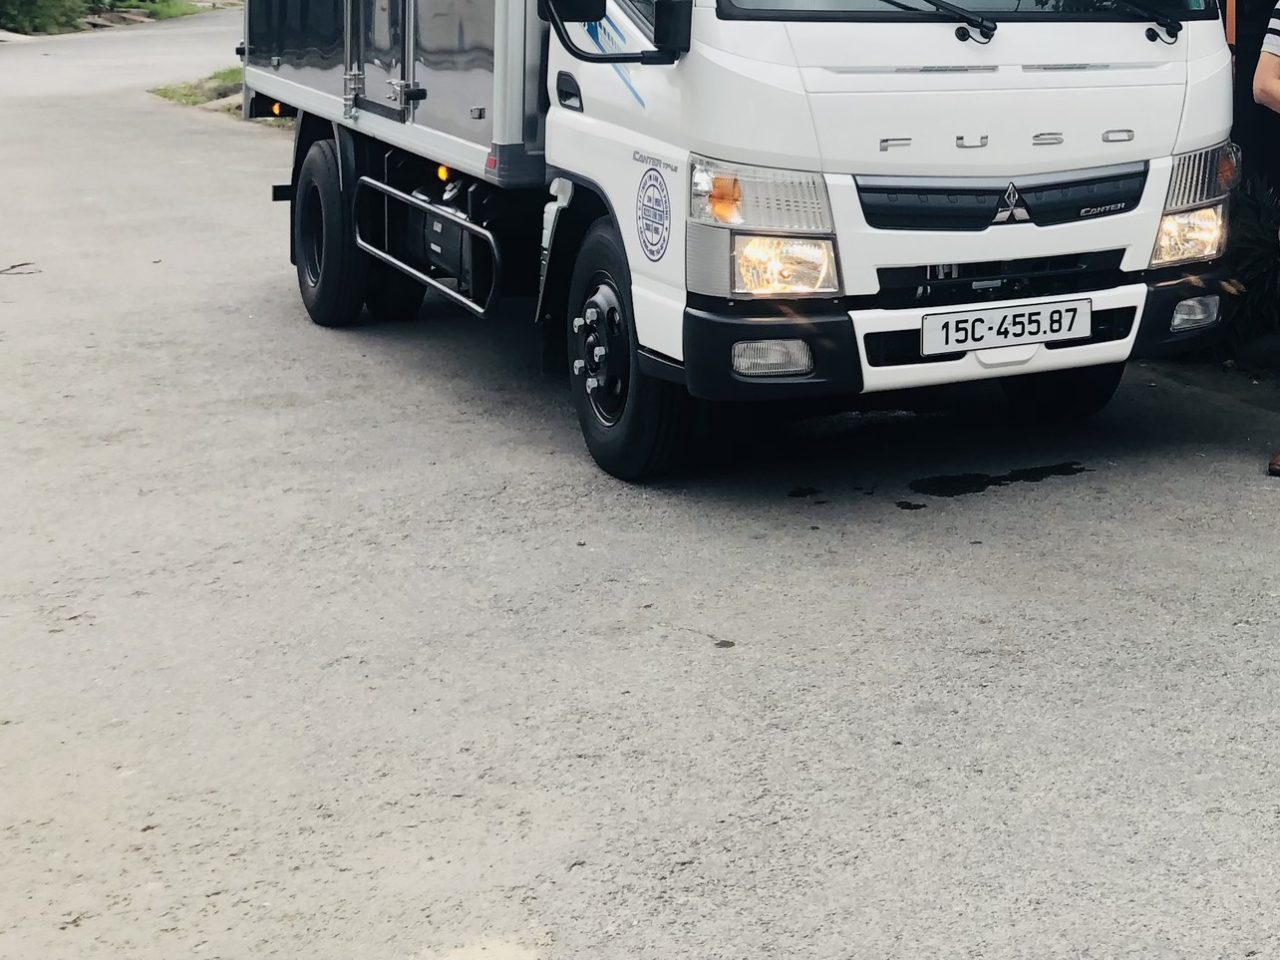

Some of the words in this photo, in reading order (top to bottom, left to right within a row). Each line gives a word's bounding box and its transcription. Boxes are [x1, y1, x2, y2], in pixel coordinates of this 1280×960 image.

[879, 128, 1135, 152] FUSO
[1079, 201, 1126, 218] CANTER
[941, 307, 1078, 346] 15C-455.87
